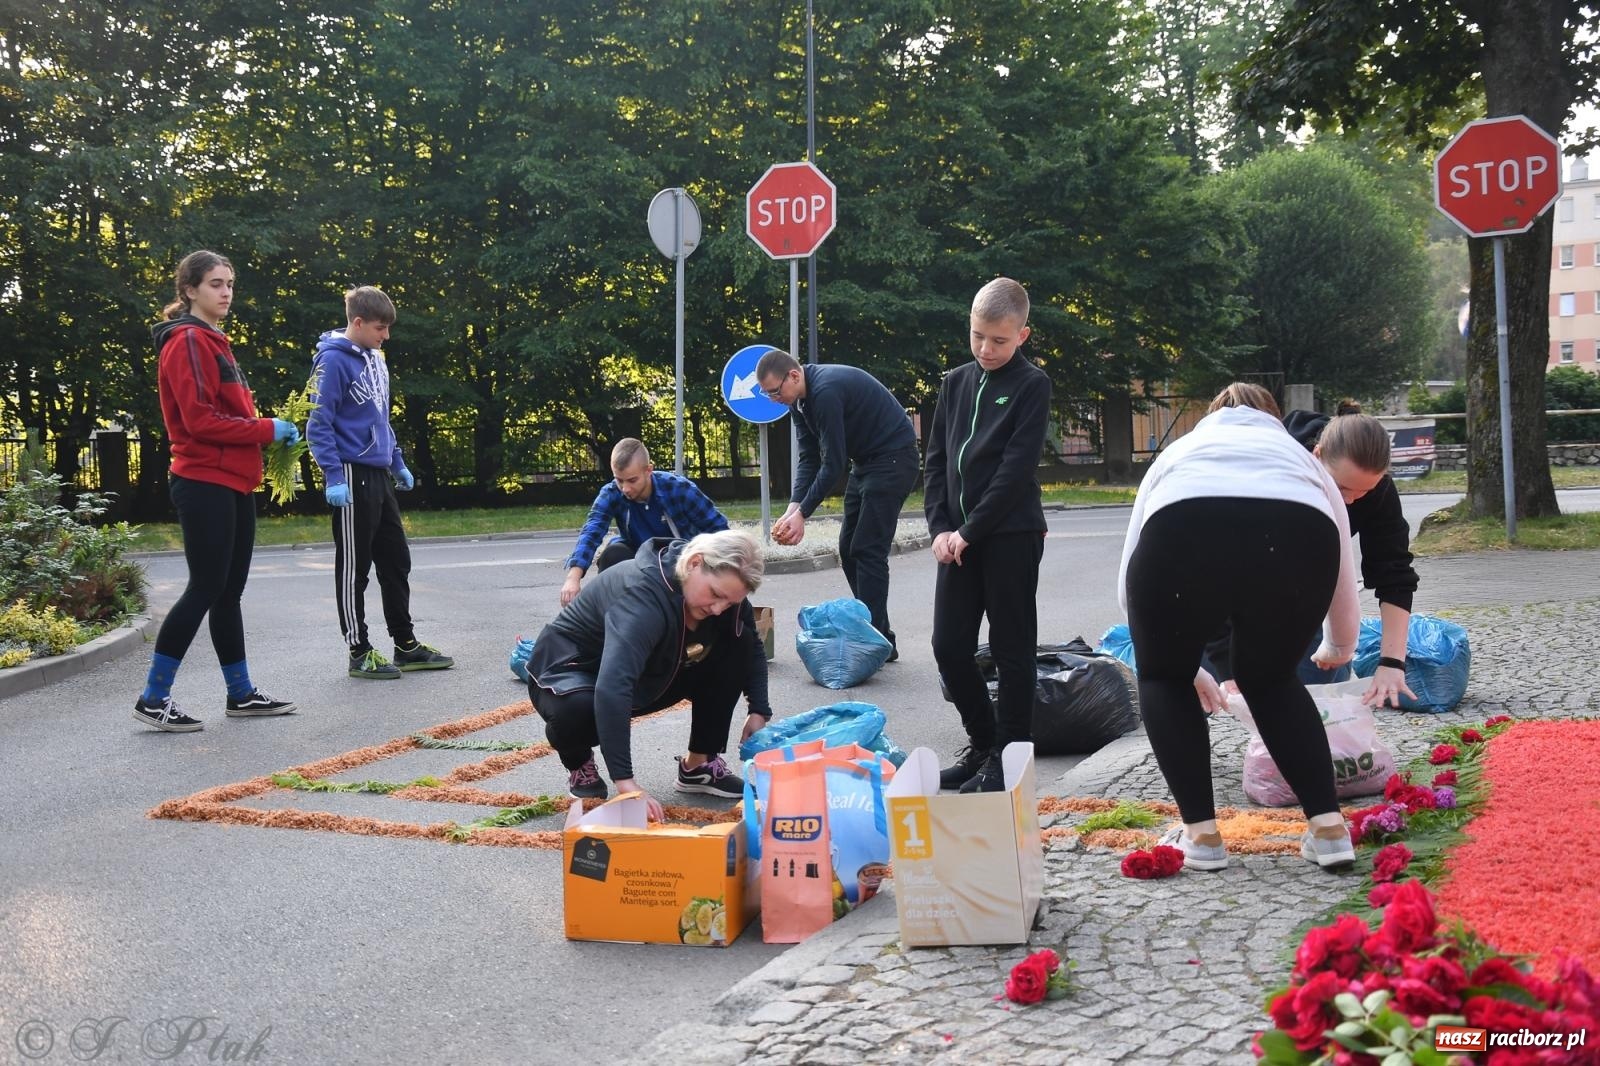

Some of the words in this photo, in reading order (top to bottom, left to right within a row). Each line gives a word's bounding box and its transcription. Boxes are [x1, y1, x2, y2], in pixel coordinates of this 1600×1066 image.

[1449, 155, 1548, 198] STOP
[757, 194, 826, 227] STOP
[775, 818, 820, 833] RIO
[902, 811, 925, 847] 1
[614, 868, 649, 879] Bagietka
[651, 870, 685, 880] ziołowa,
[626, 880, 672, 888] czosnkowa
[623, 887, 656, 898] Baguete
[620, 897, 659, 908] Manteiga
[660, 899, 680, 907] sort.
[905, 908, 922, 919] dla
